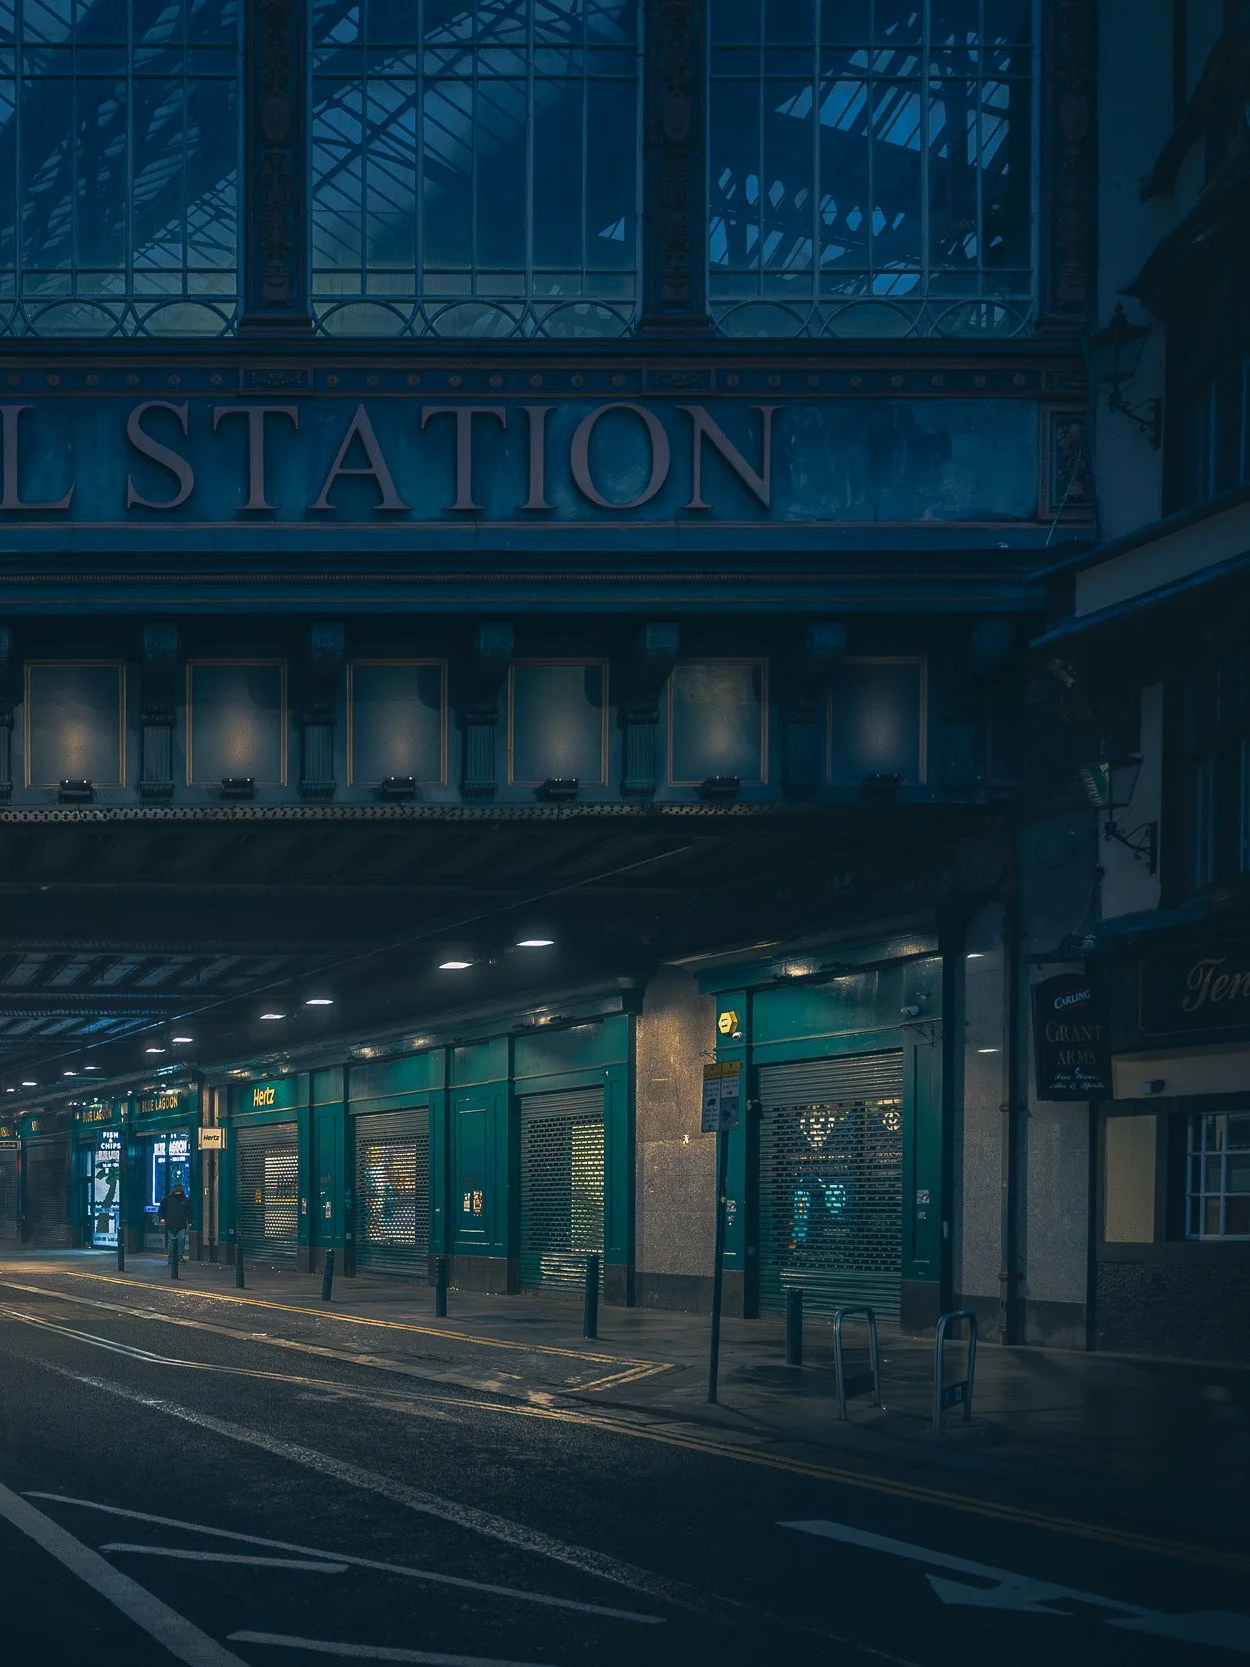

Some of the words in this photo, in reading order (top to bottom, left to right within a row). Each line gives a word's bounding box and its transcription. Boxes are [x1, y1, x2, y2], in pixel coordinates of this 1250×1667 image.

[125, 399, 787, 512] STATION
[1053, 989, 1091, 1010] CARLING
[1045, 1020, 1103, 1043] GRANT
[1056, 1049, 1097, 1066] ARMS
[141, 1099, 154, 1113] BLUE
[155, 1095, 179, 1112] LAGOON
[253, 1086, 275, 1107] Hertz
[100, 1142, 121, 1150] CHIPS
